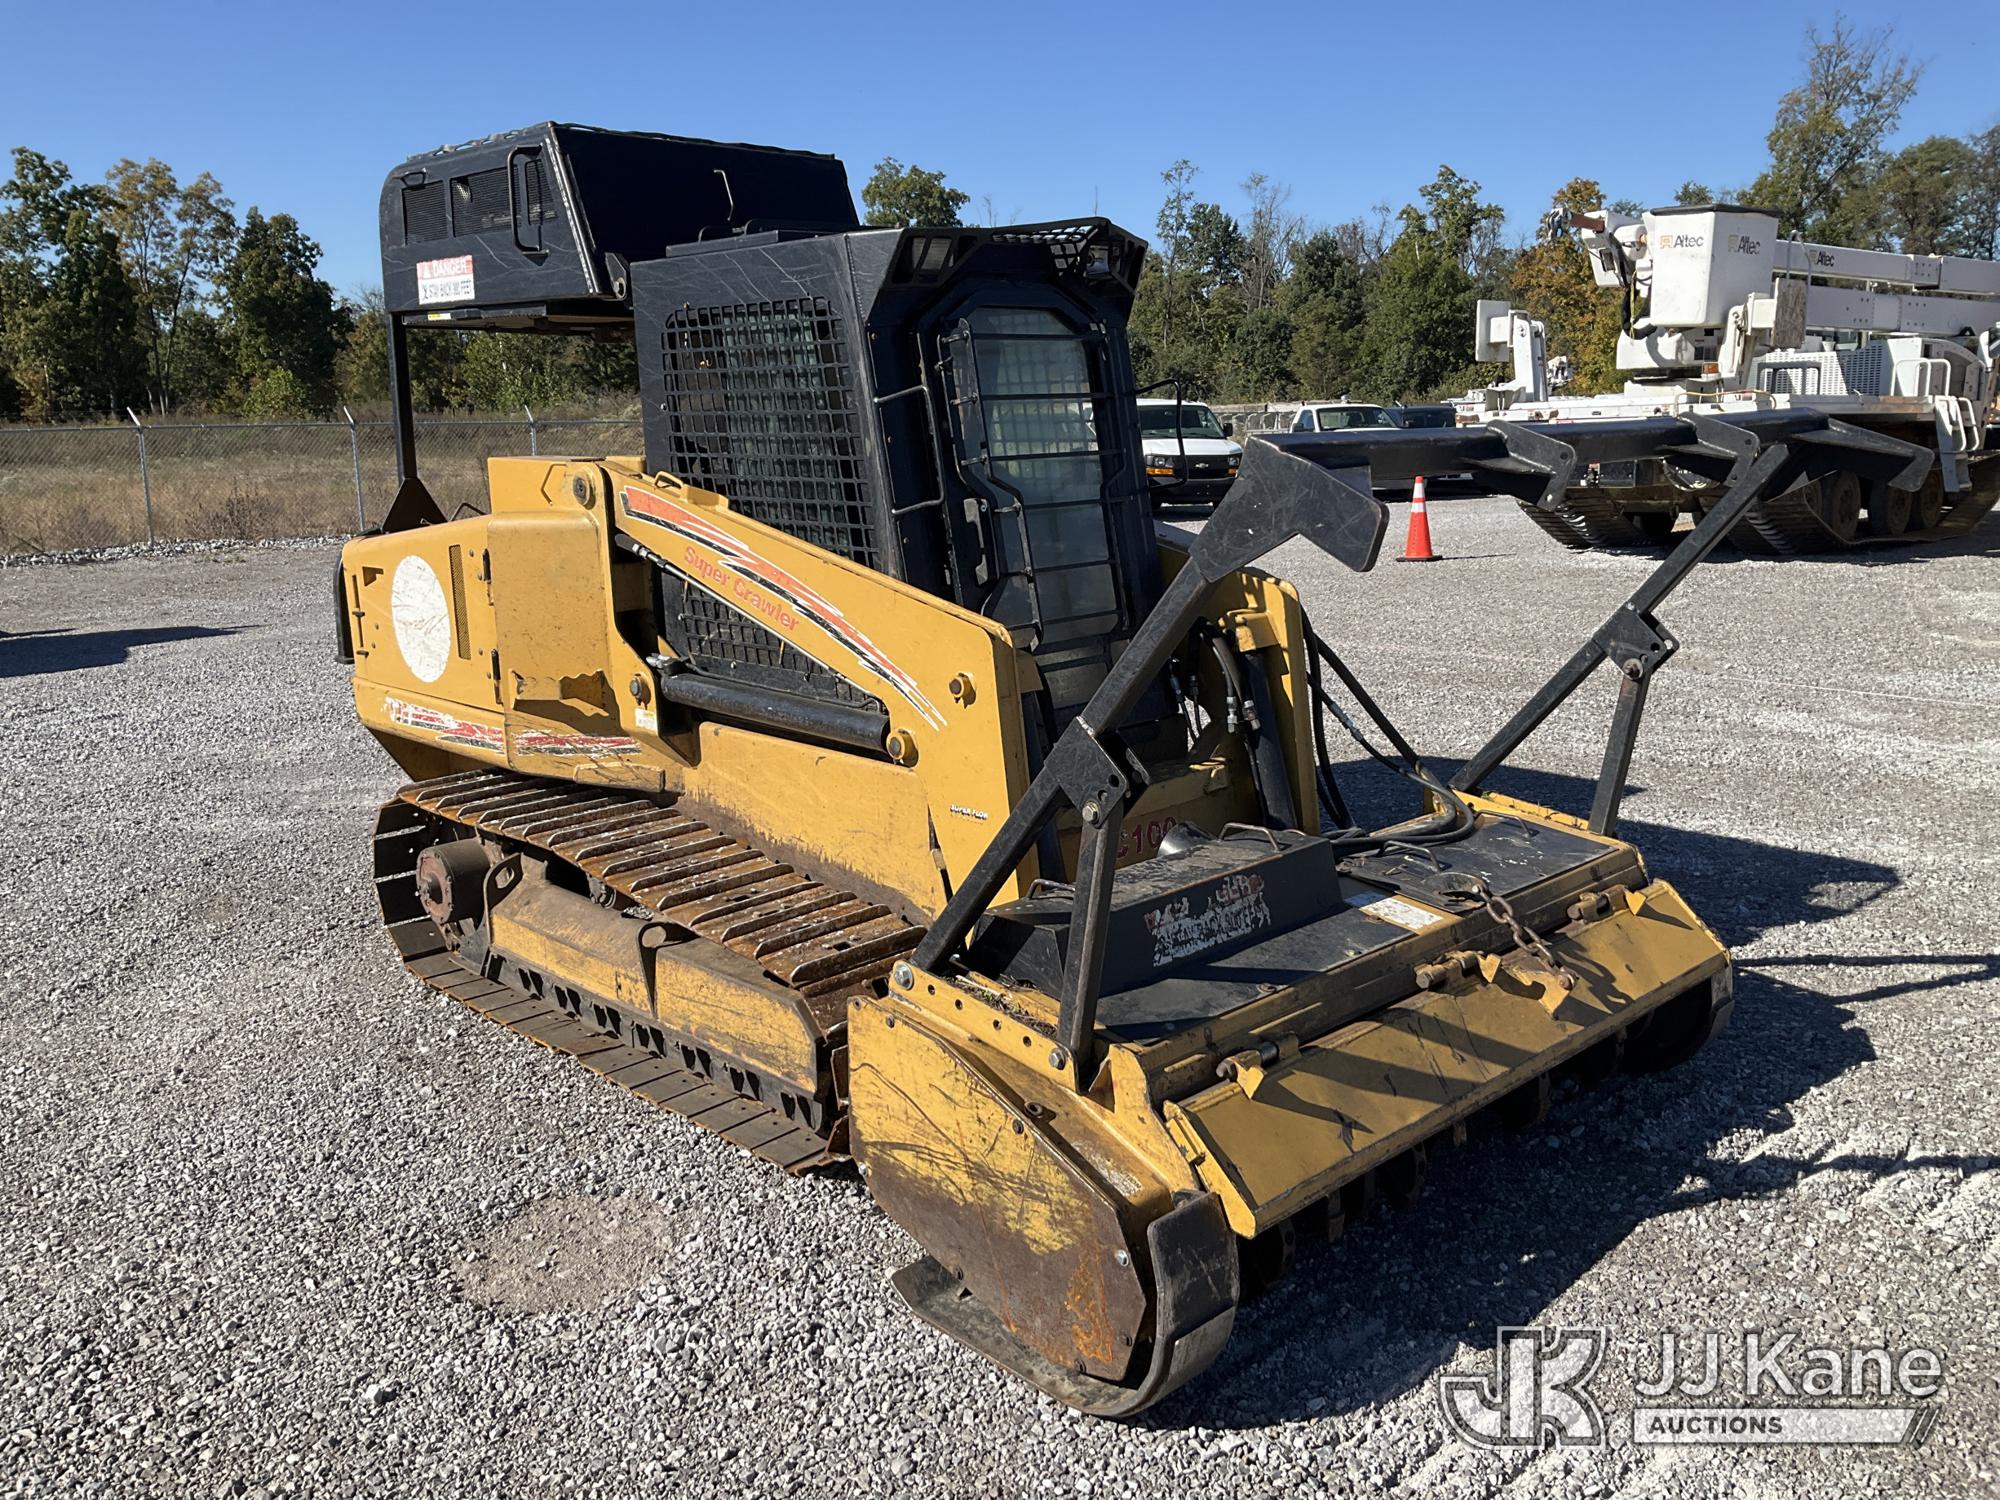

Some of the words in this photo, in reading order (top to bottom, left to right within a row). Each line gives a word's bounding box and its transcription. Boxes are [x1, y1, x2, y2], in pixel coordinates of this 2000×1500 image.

[1673, 234, 1704, 248] Altec
[1737, 236, 1761, 255] Altec
[432, 258, 467, 277] DANGER
[1816, 250, 1835, 267] Altec
[684, 546, 730, 586] Super
[733, 577, 800, 631] Crawler
